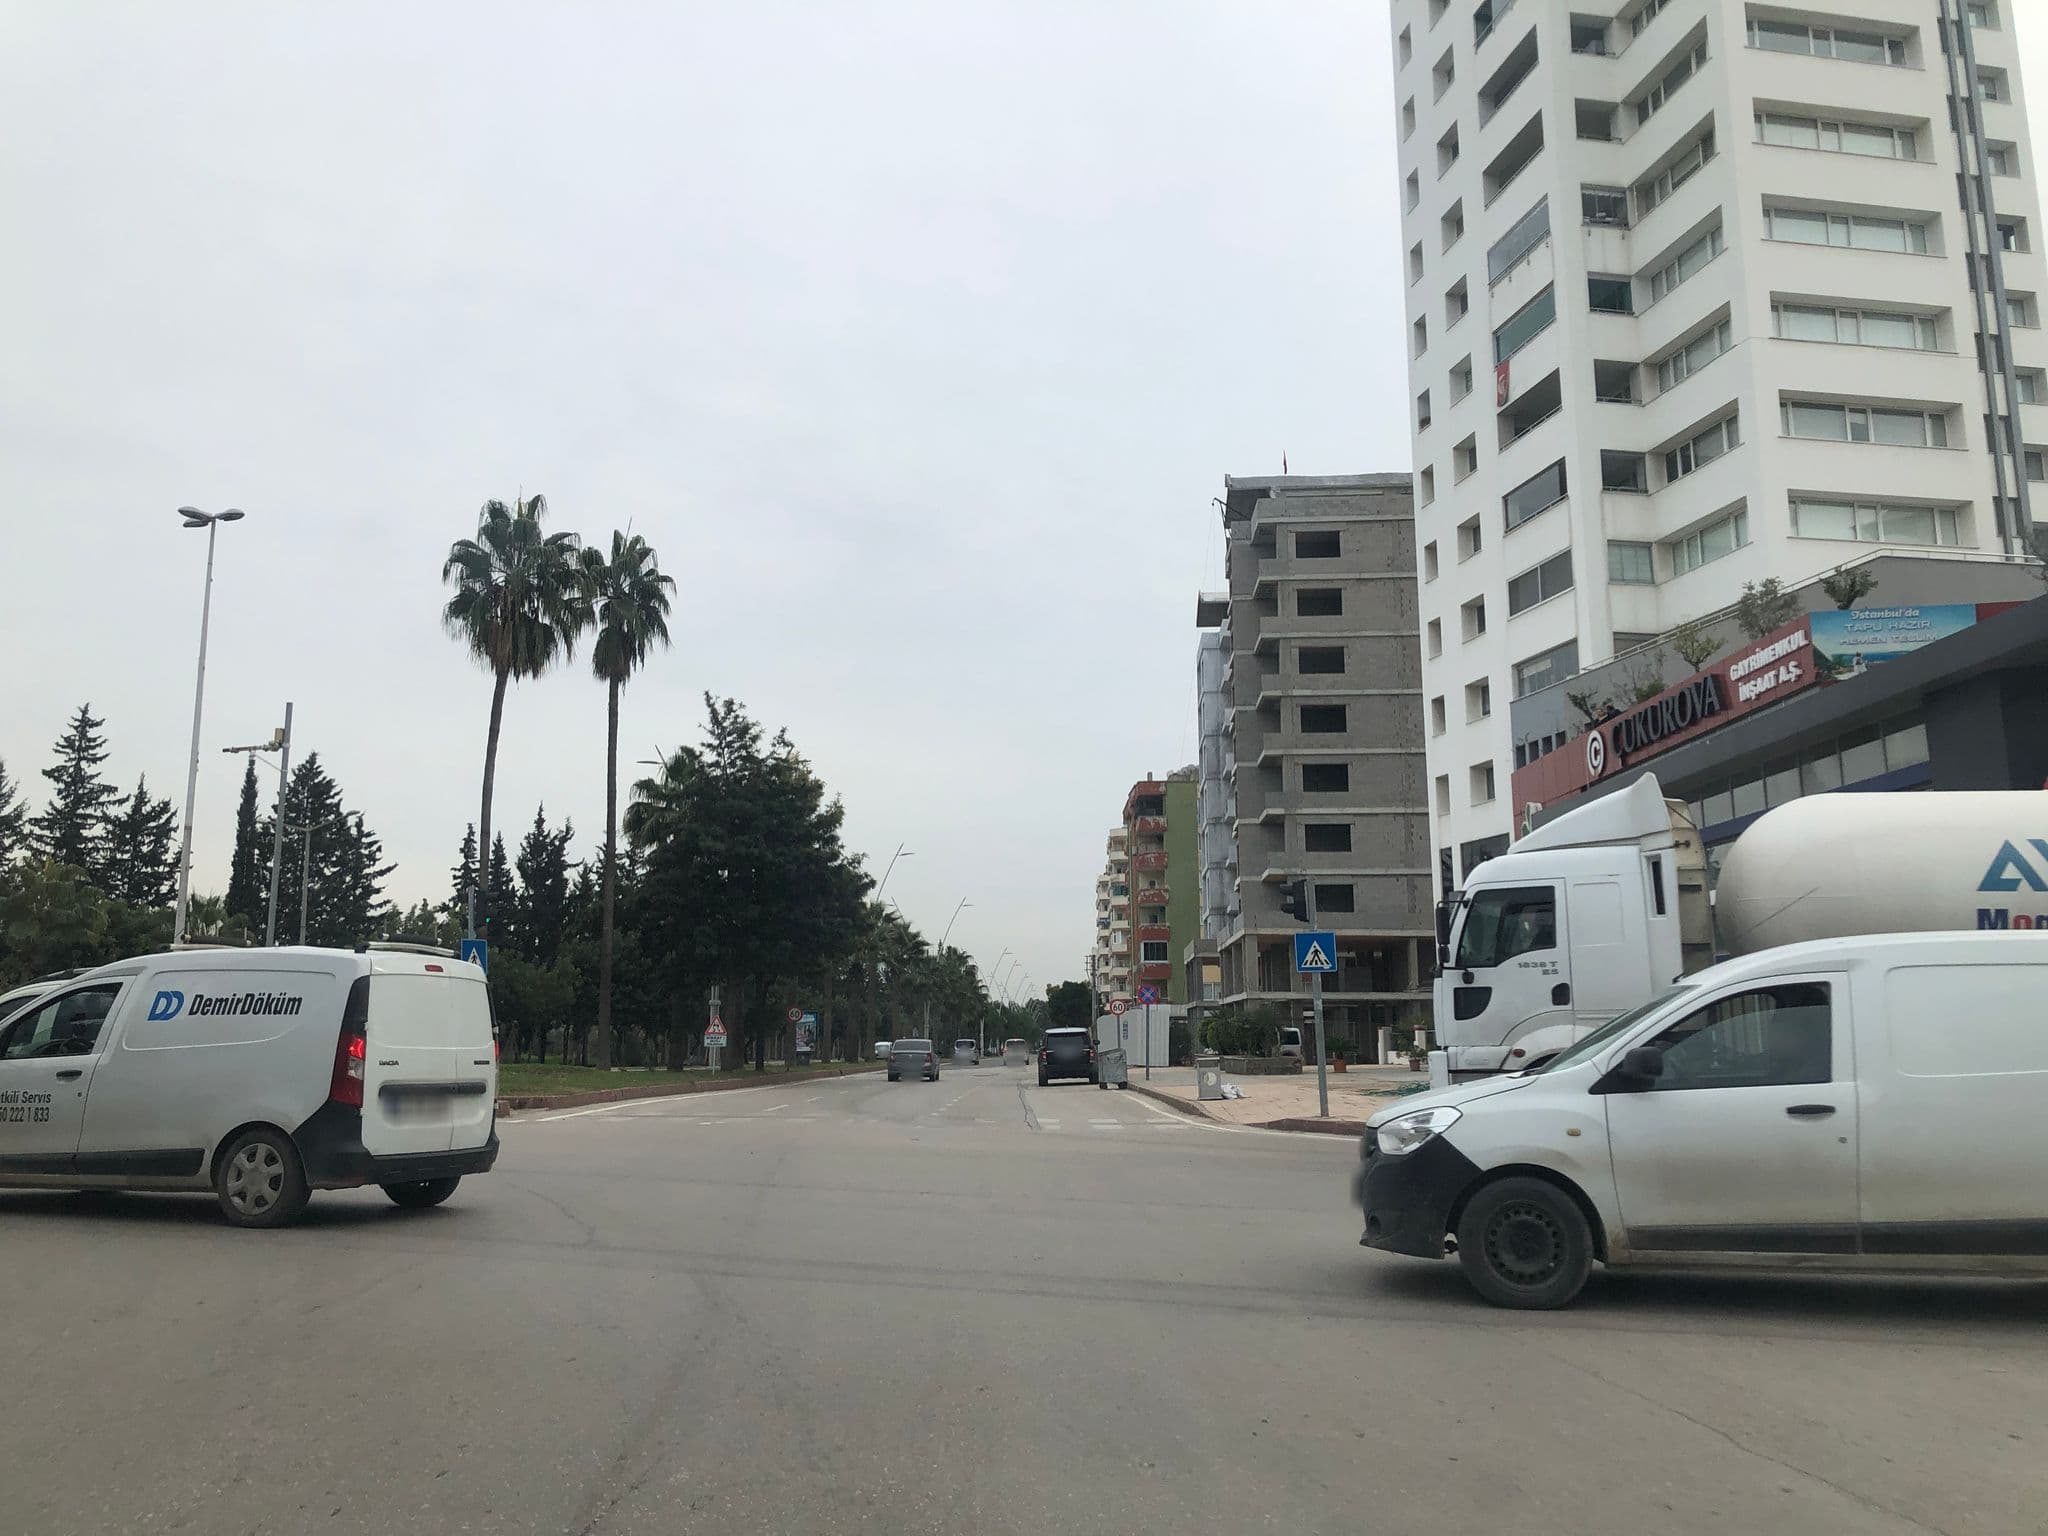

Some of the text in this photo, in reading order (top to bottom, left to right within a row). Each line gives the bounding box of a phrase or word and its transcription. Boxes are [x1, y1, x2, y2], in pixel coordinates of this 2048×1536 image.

[1844, 620, 1931, 632] TAPU HAZIR
[1610, 675, 1721, 767] ÇUKUROVA
[188, 992, 303, 1016] DemirDöküm
[1113, 1003, 1123, 1011] 60
[790, 1010, 800, 1019] 60
[22, 1090, 52, 1104] Servis
[9, 1106, 25, 1122] 222
[33, 1106, 50, 1122] 833
